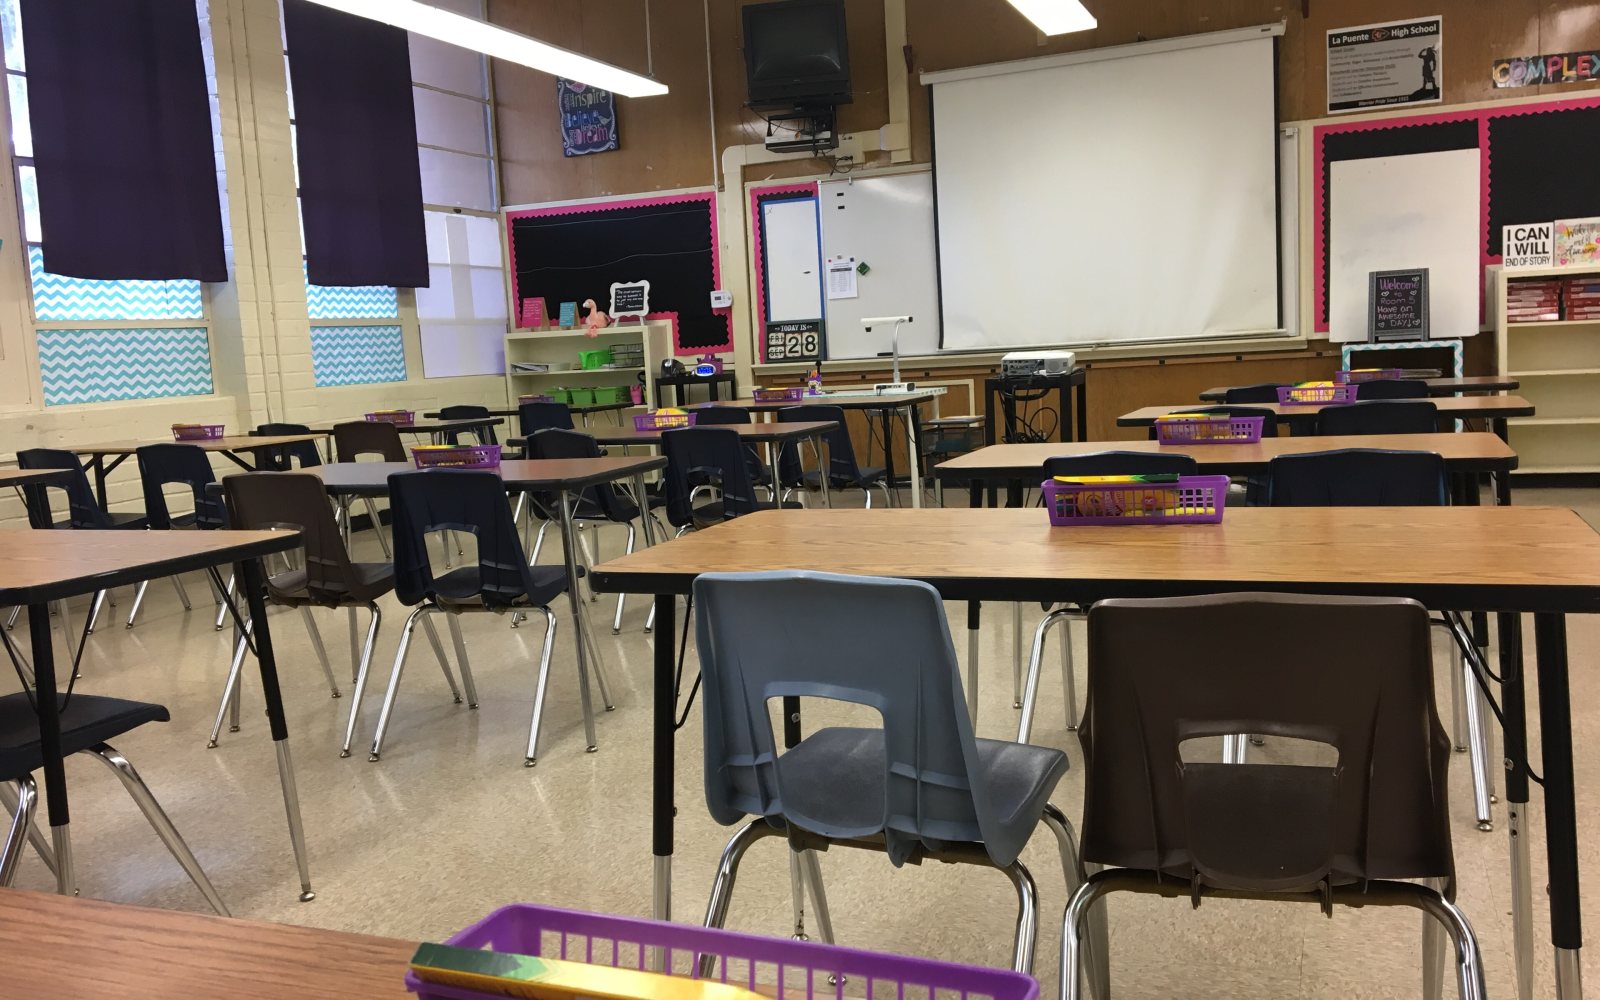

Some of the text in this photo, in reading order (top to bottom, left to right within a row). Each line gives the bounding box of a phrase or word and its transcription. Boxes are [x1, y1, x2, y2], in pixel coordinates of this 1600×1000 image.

[1332, 37, 1341, 45] La
[1342, 33, 1370, 44] Puente
[1391, 28, 1409, 38] High
[1410, 24, 1437, 34] School
[1507, 226, 1550, 242] I CAN
[1506, 244, 1511, 257] I
[1515, 241, 1550, 256] WILL
[1505, 256, 1551, 267] END OF STORY
[1380, 278, 1419, 290] Welcome
[1380, 297, 1406, 305] Room
[1377, 305, 1398, 313] Have
[770, 335, 783, 343] FRI
[769, 349, 784, 357] SEP
